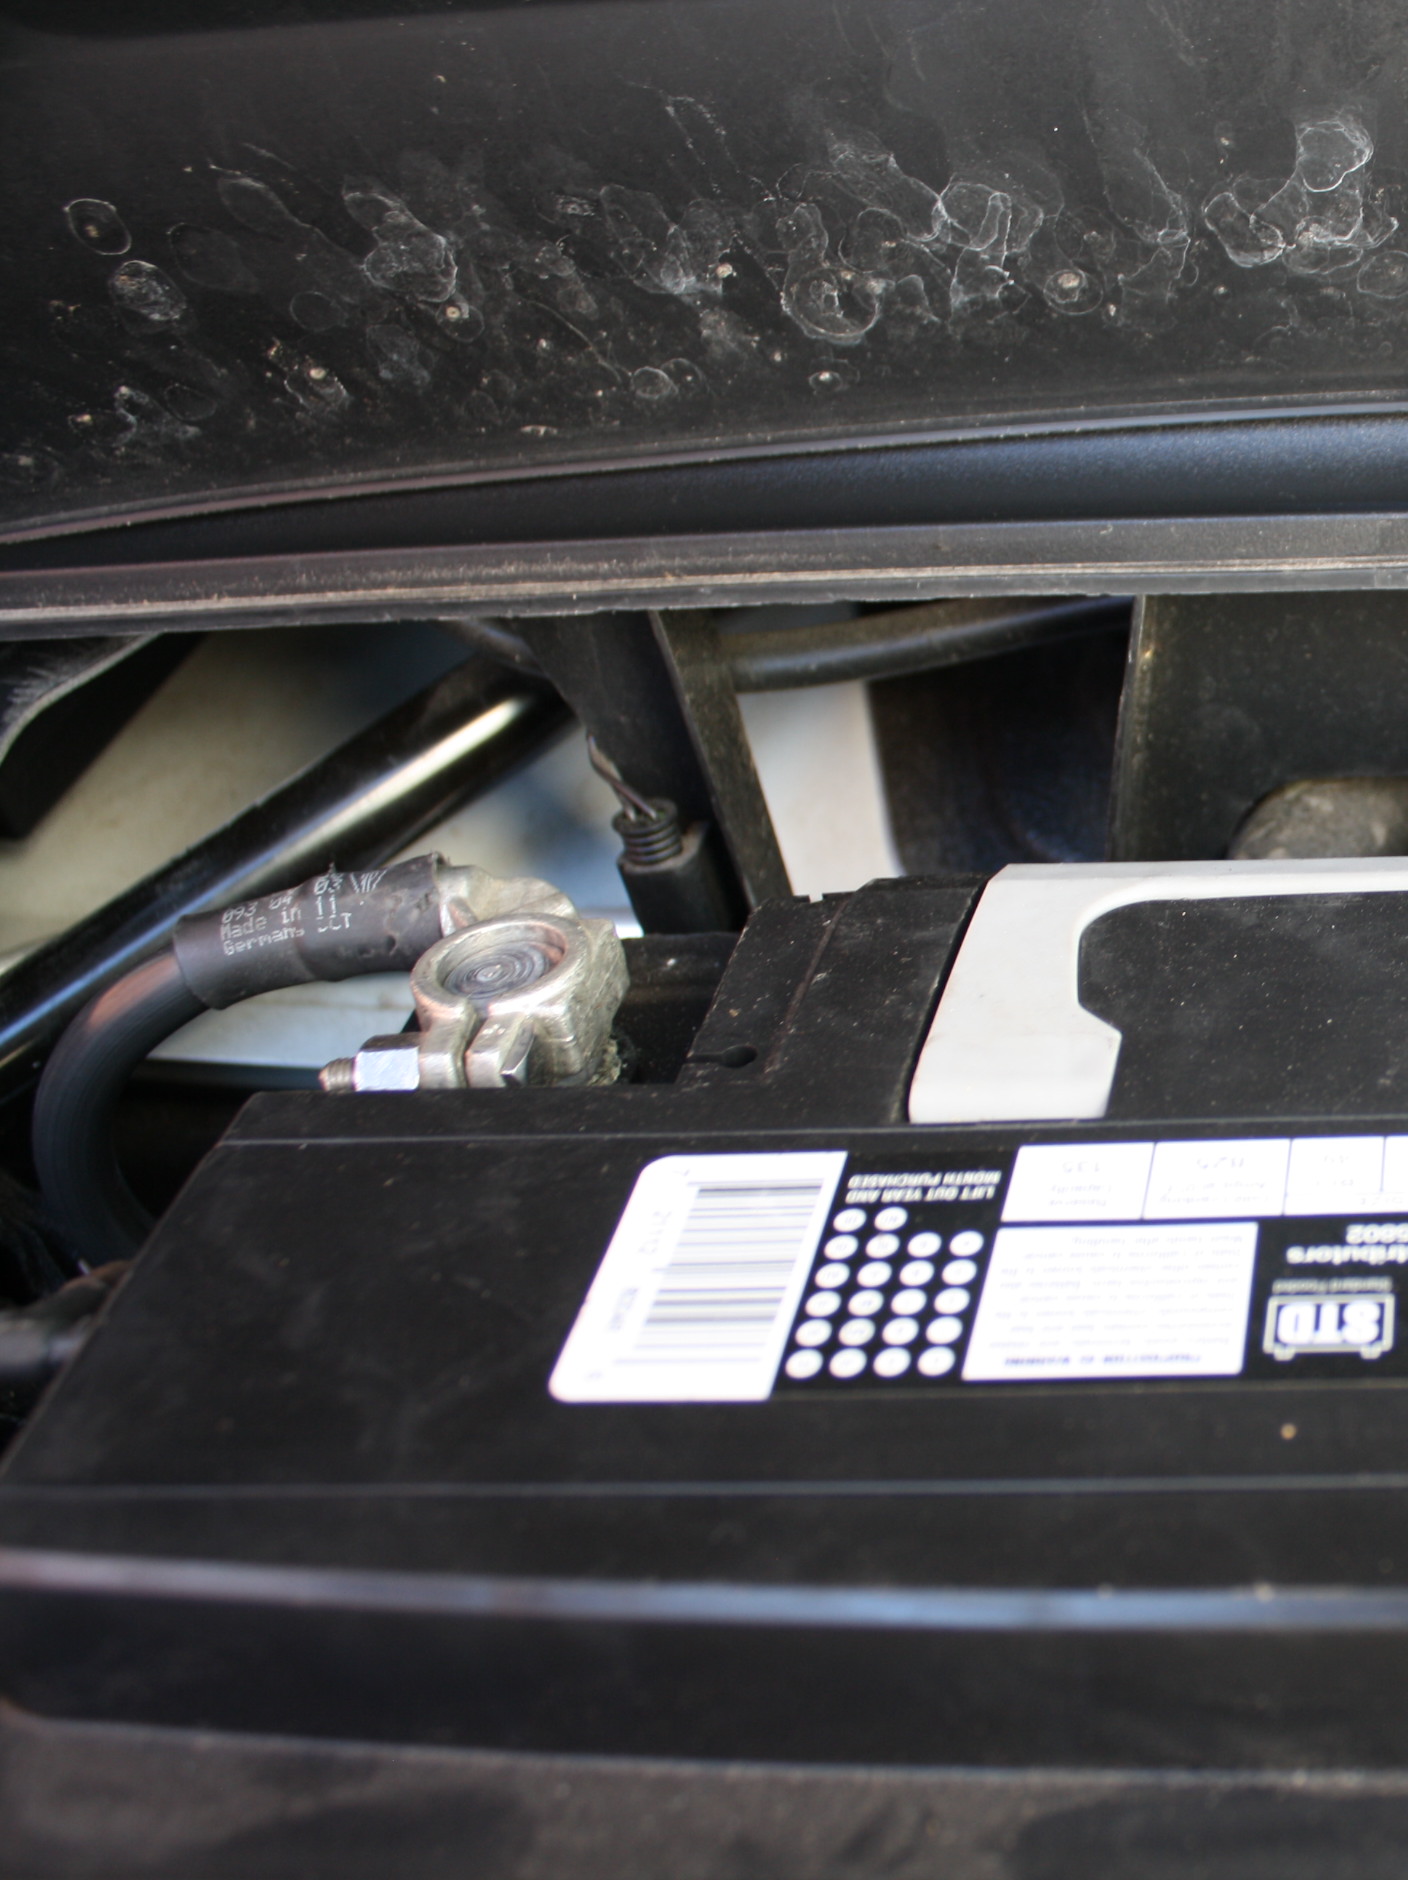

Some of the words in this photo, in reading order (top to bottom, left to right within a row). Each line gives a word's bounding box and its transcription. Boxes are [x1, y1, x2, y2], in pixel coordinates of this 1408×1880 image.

[220, 916, 267, 940] Made
[281, 907, 301, 924] in
[848, 1172, 942, 1188] PURCHASED
[943, 1171, 1001, 1185] MONTH
[845, 1189, 881, 1203] AND
[881, 1188, 922, 1202] YEAR
[925, 1187, 959, 1201] OUT
[960, 1185, 996, 1200] LIFT
[1276, 1300, 1381, 1345] STD
